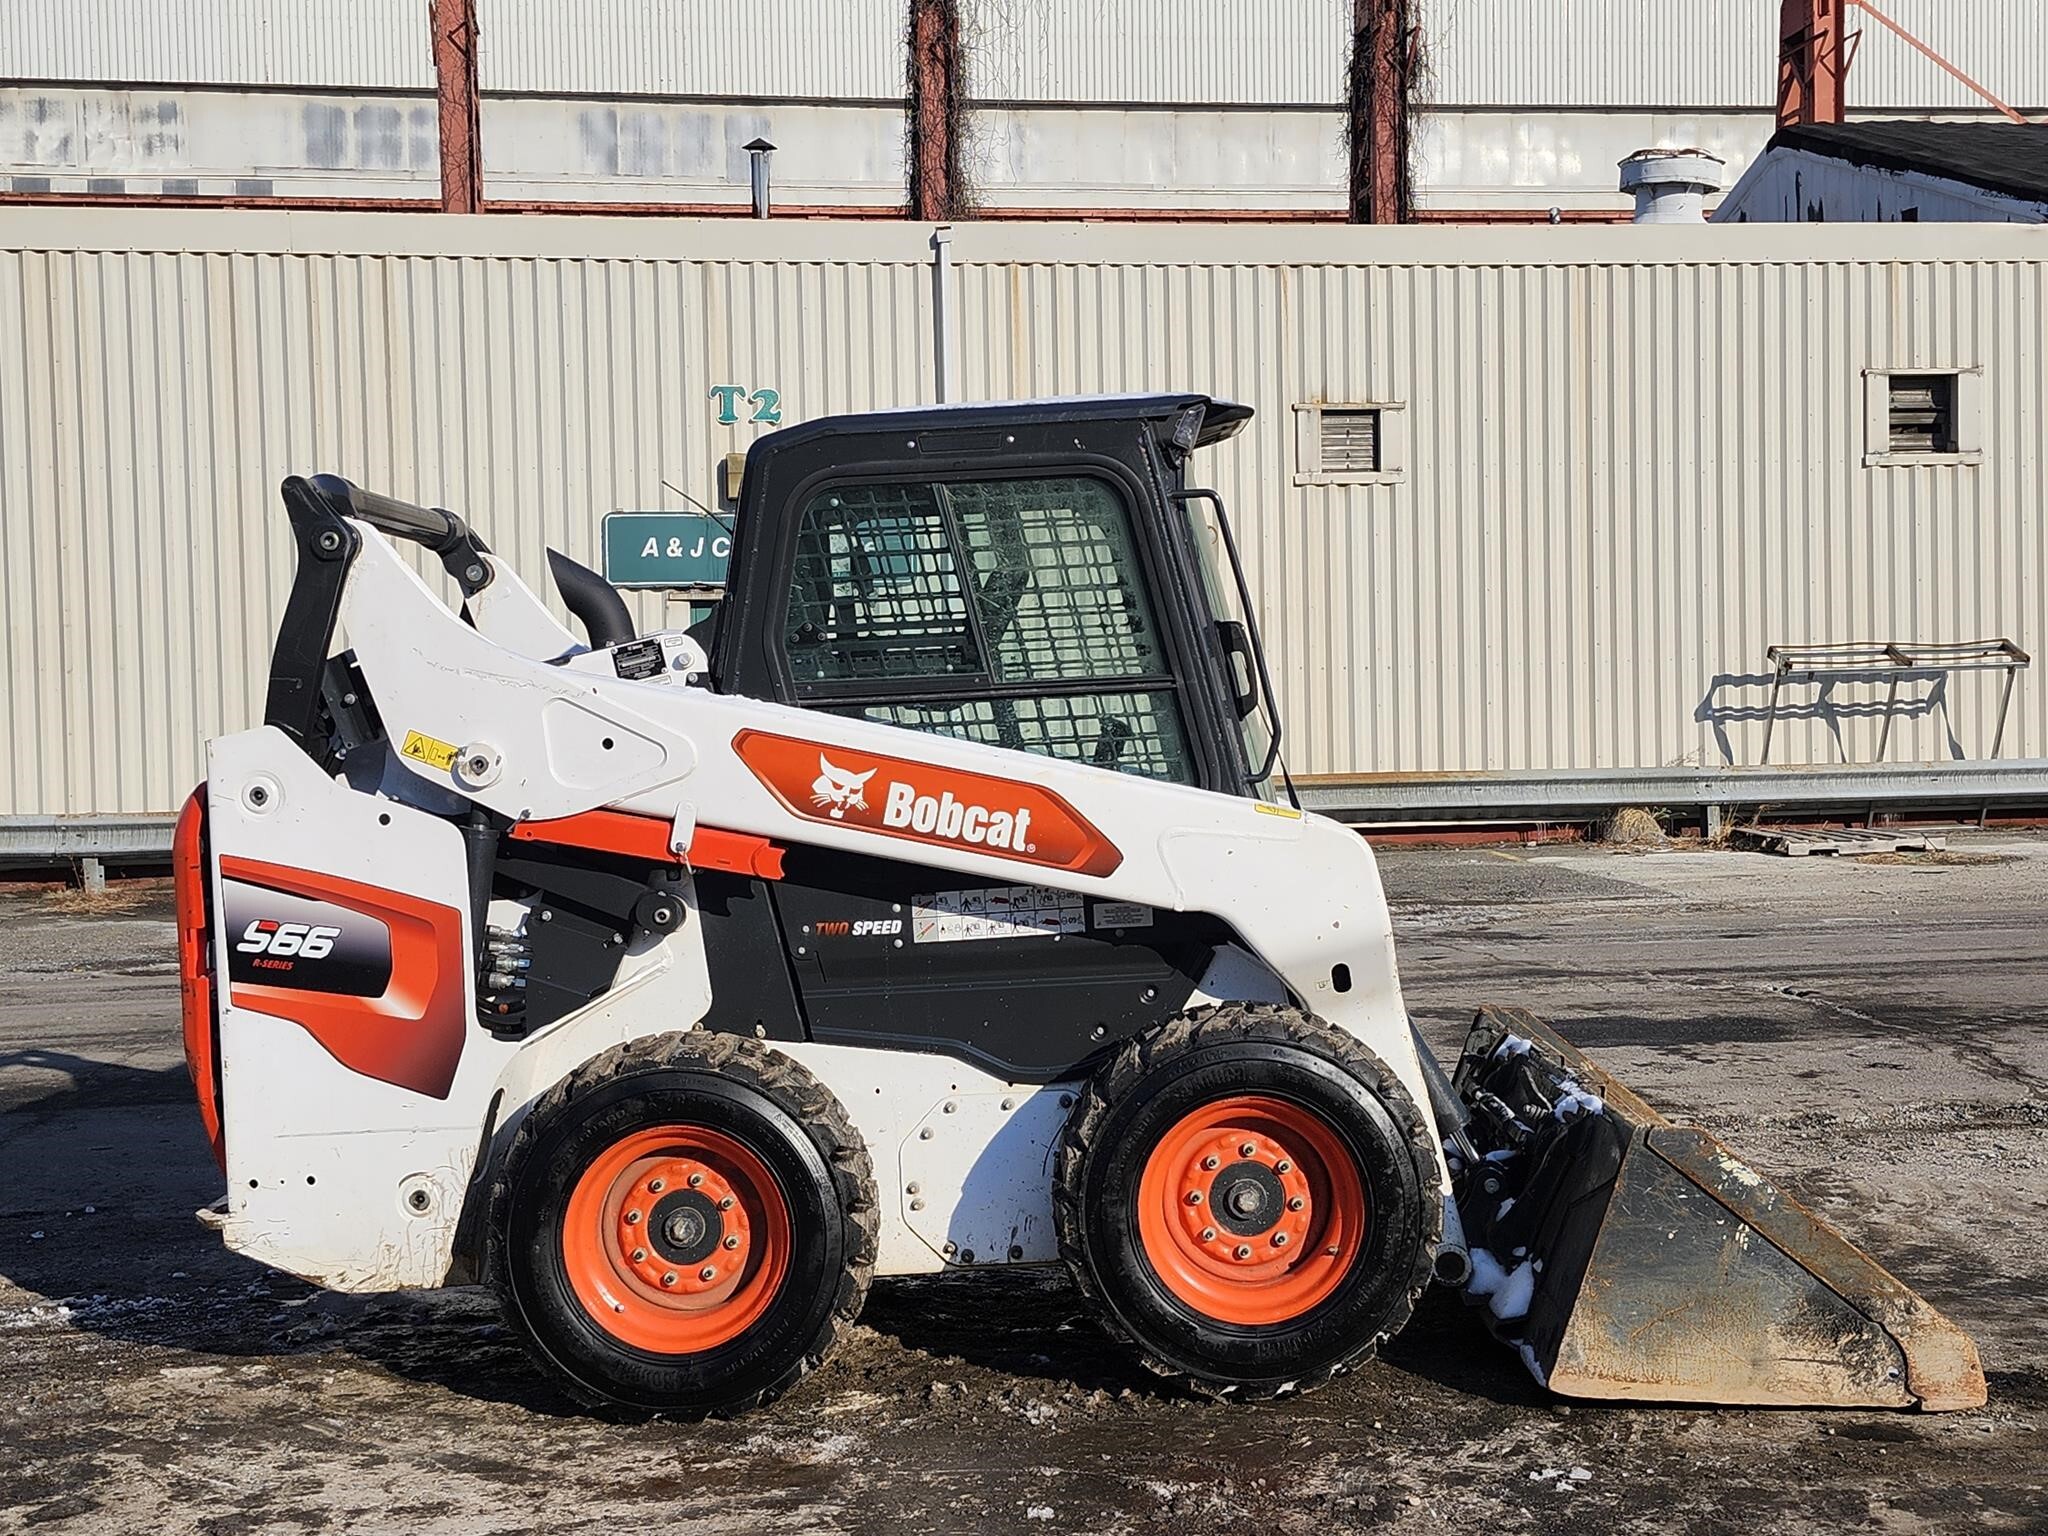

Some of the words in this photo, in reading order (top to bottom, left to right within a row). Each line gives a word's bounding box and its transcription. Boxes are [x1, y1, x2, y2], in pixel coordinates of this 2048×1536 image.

[709, 384, 782, 424] T2
[883, 781, 1031, 852] Bobcat
[236, 920, 342, 959] S66
[816, 922, 849, 935] TWO
[852, 920, 902, 935] SPEED
[252, 959, 294, 970] R-SERIES
